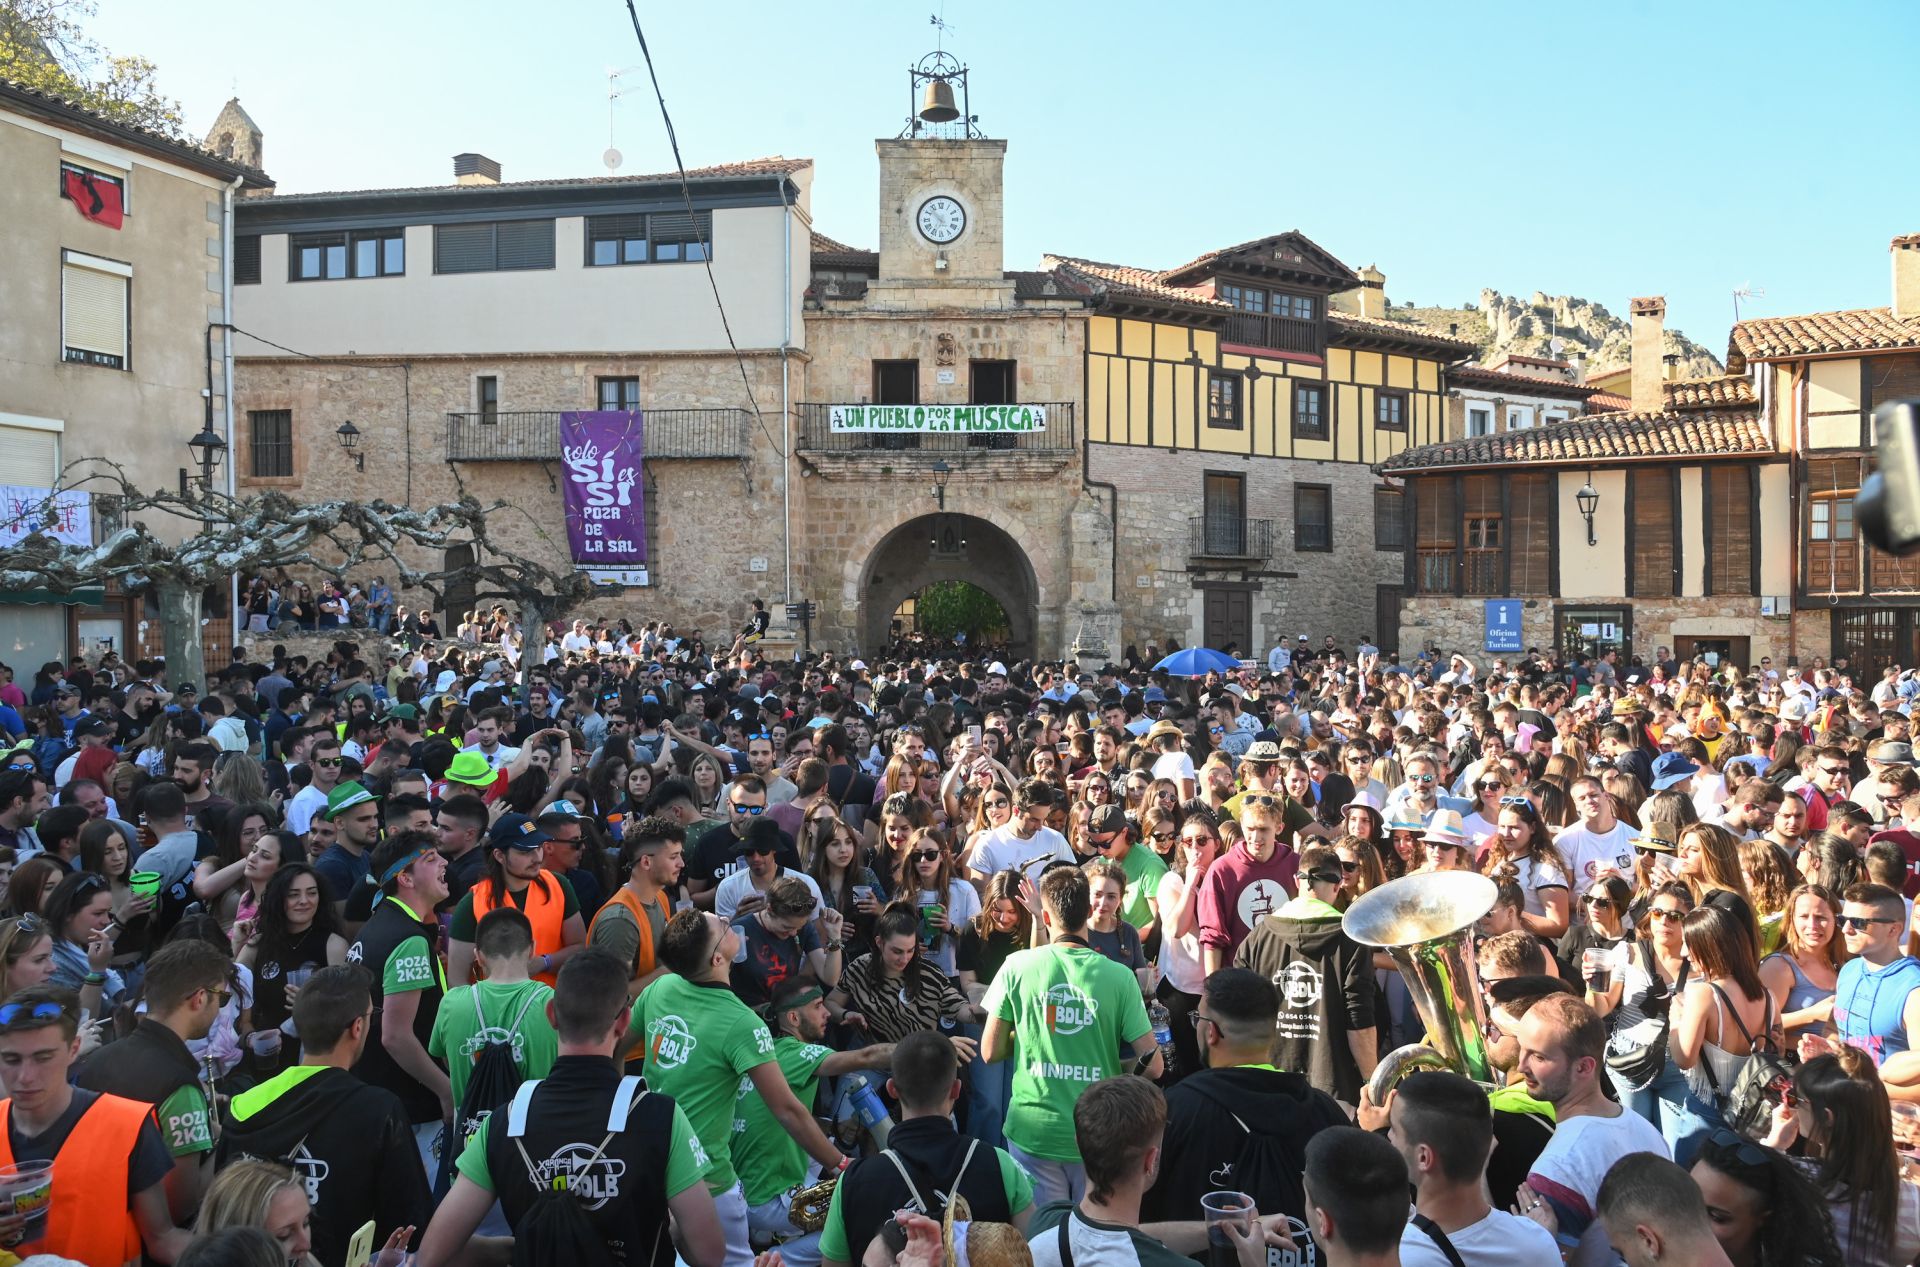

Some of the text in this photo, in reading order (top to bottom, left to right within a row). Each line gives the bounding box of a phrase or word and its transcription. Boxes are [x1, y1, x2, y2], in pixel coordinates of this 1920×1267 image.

[845, 407, 925, 428] UN PUEBLO
[928, 407, 951, 419] POR
[929, 421, 949, 431] LA
[618, 467, 639, 486] es
[583, 507, 620, 519] POZA
[585, 523, 602, 536] DE
[585, 540, 637, 552] LA SAL
[1490, 629, 1517, 637] Oficina
[714, 863, 737, 879] ell
[396, 956, 429, 969] POZA
[397, 967, 430, 982] 2K22
[1030, 1062, 1101, 1081] MINIPELE
